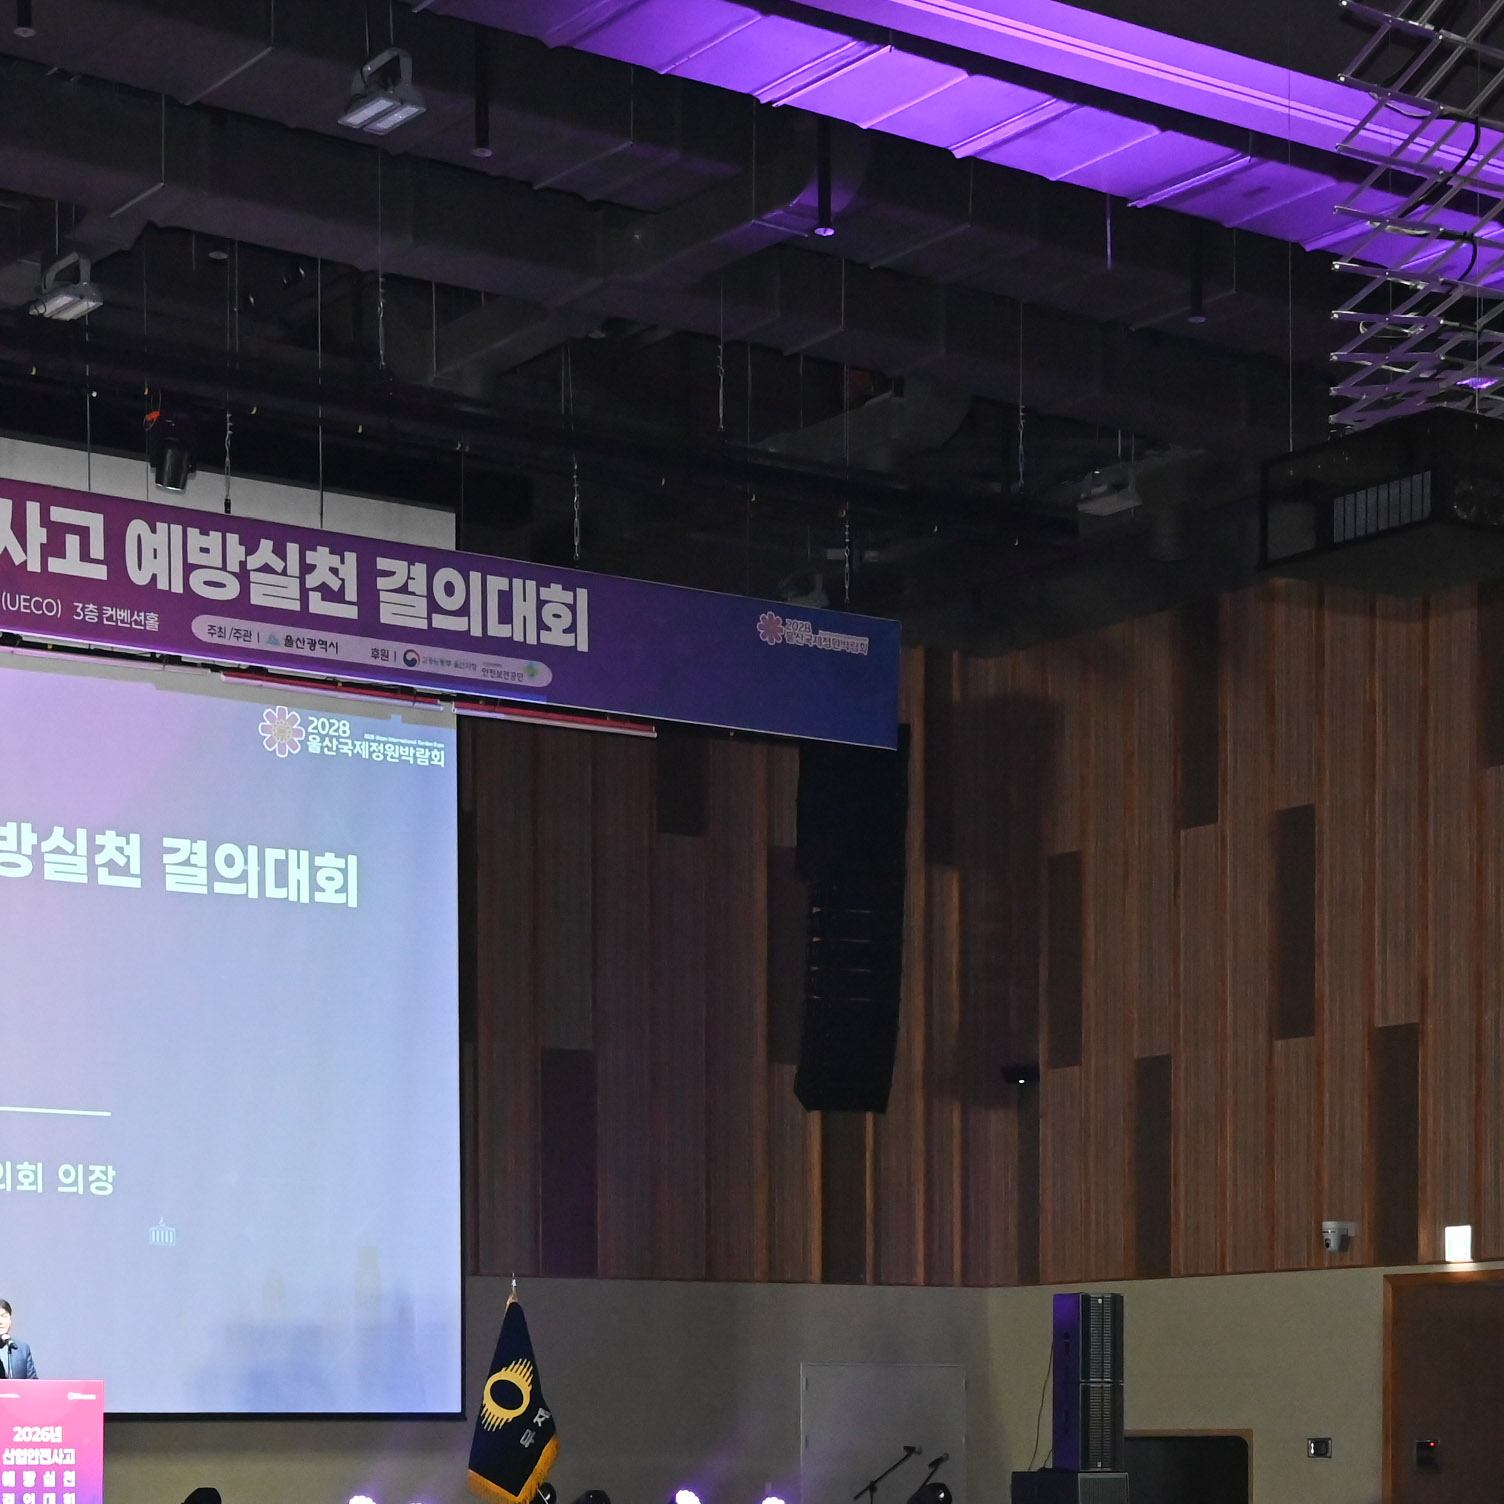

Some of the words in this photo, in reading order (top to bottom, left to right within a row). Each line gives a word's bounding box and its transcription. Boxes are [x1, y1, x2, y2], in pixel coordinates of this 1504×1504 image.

[124, 518, 359, 620] 예방실천
[376, 556, 589, 652] 결의대회
[2, 591, 62, 618] (UECO)
[73, 601, 98, 623] 3층
[102, 603, 160, 632] 컨벤션홀
[785, 619, 812, 633] 2028
[284, 634, 339, 654] 울산광역시
[370, 648, 389, 662] 후원
[307, 716, 350, 737] 2028
[307, 735, 445, 767] 울산국제정원박람회
[163, 836, 358, 908] 결의대회
[57, 1162, 116, 1196] 의장
